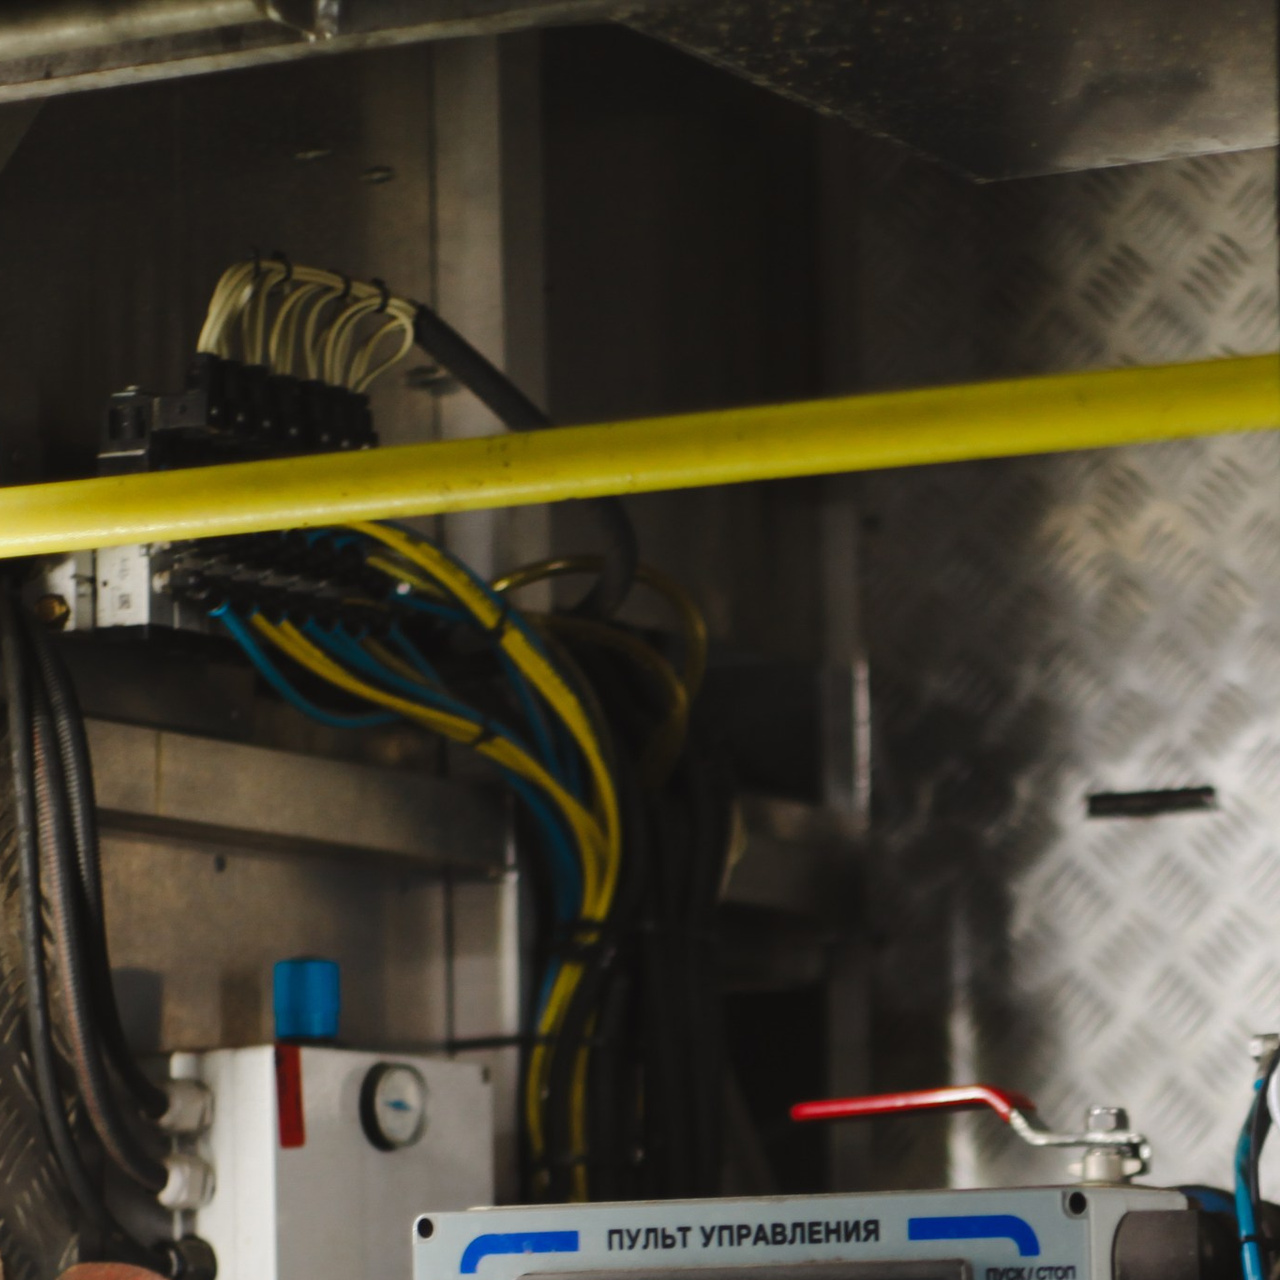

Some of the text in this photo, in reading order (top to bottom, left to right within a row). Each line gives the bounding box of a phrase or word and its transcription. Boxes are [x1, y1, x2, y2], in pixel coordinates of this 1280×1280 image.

[607, 1219, 880, 1250] ПУЛЬТ УПРАВЛЕНИЯ
[1036, 1265, 1077, 1280] СТОП
